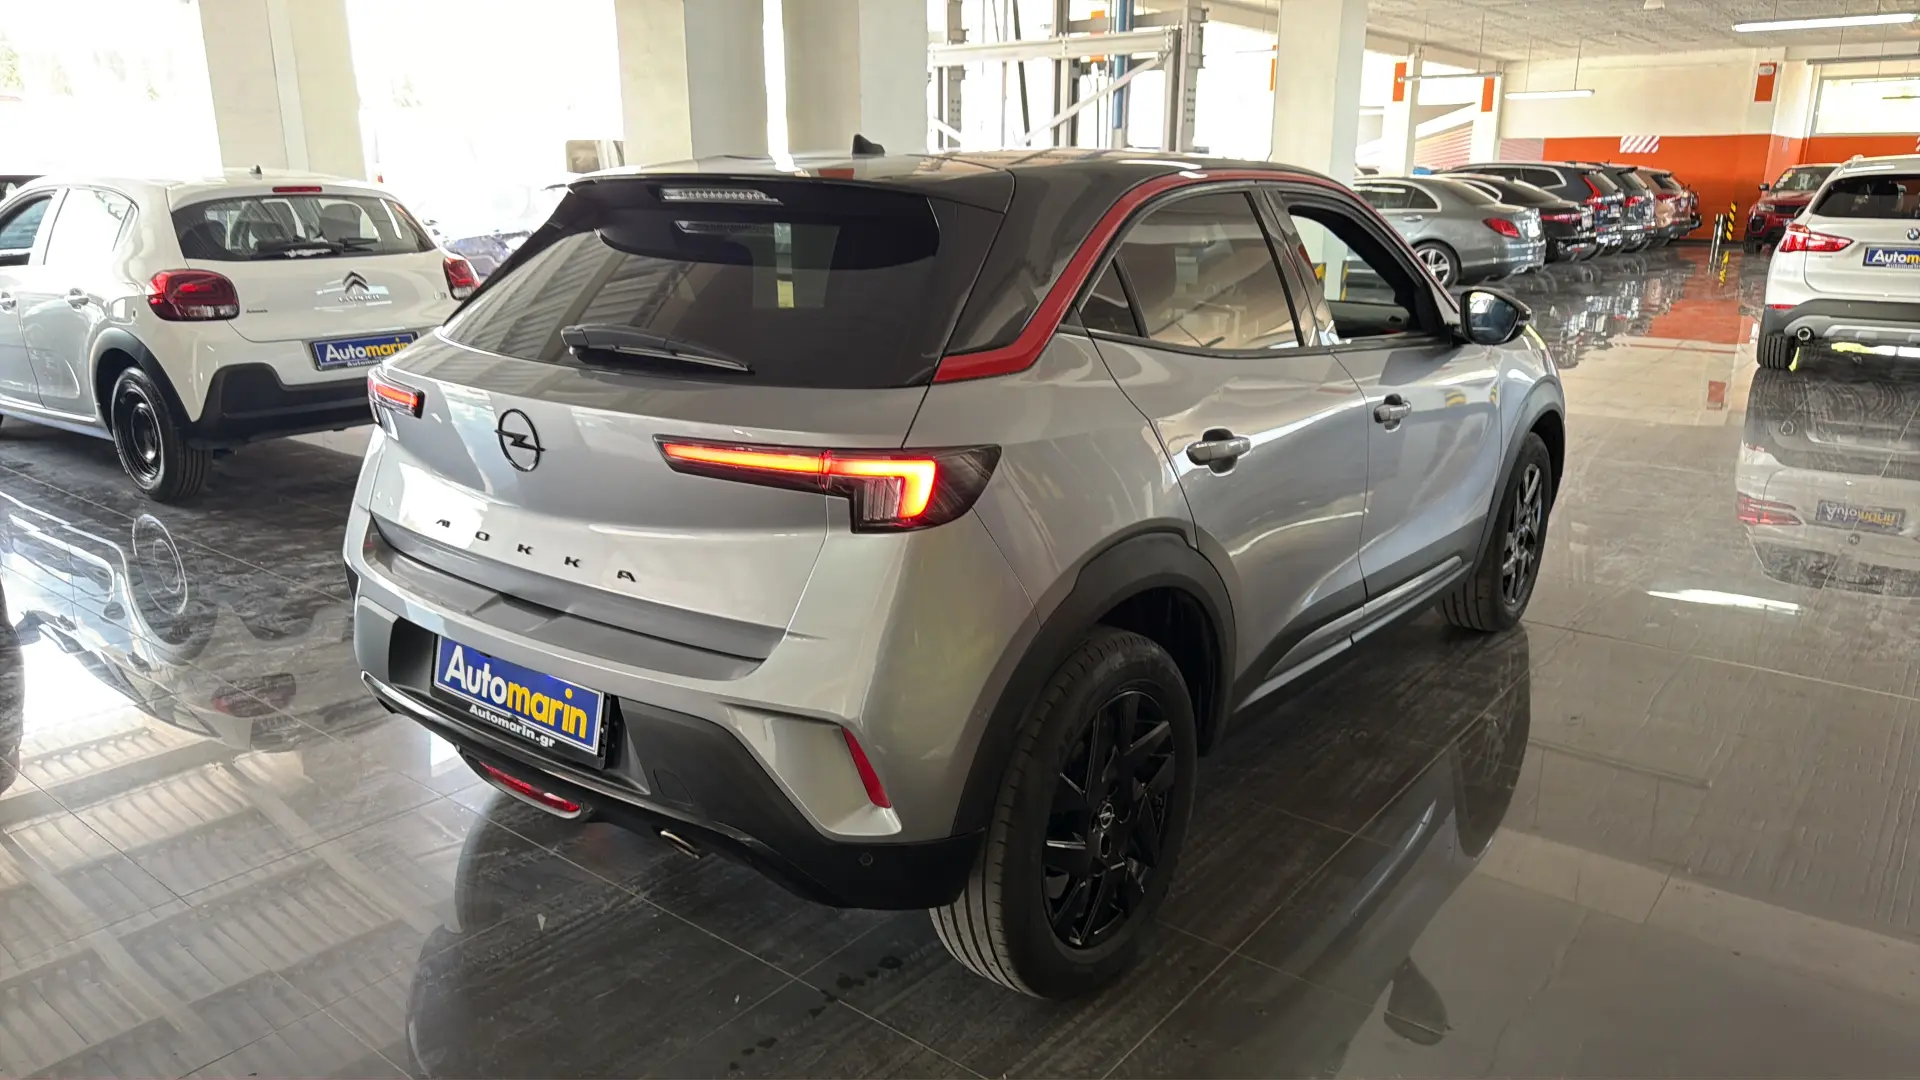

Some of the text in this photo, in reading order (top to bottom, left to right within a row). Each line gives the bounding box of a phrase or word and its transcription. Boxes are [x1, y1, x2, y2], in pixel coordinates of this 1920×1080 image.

[1872, 249, 1920, 264] Autom
[444, 644, 588, 739] Automarin
[469, 704, 556, 748] Automarin.gr
